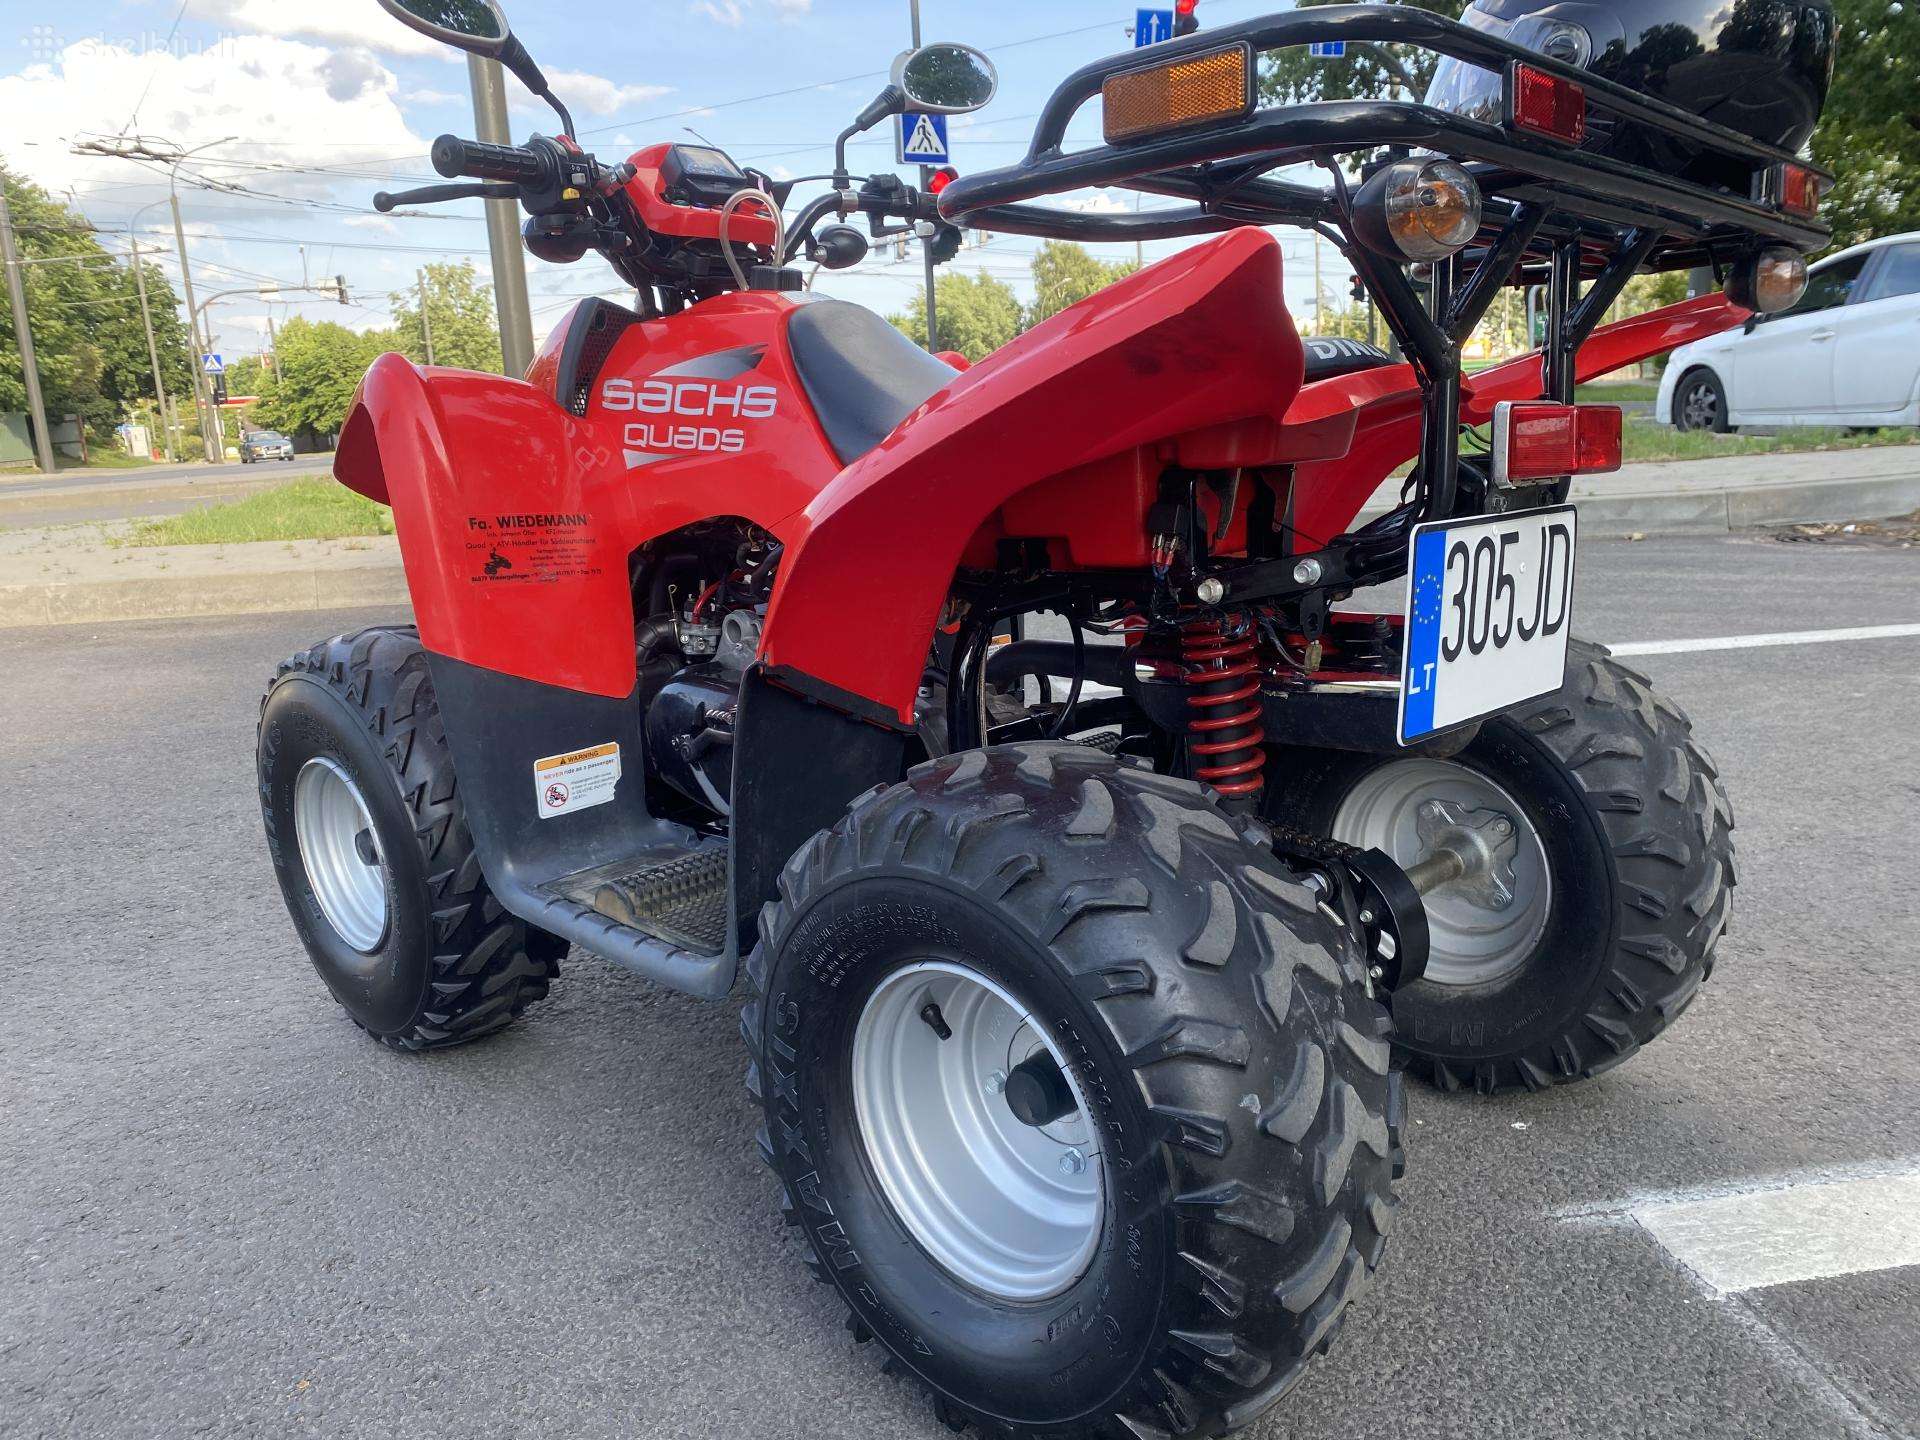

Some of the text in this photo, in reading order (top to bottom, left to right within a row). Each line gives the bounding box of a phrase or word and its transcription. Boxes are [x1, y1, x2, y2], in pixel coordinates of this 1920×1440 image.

[468, 514, 588, 530] Fa. WIEDEMANN
[1441, 523, 1570, 663] 305JD
[1408, 663, 1435, 695] LT
[567, 750, 599, 763] WARNING
[587, 758, 614, 770] passenger
[772, 992, 862, 1271] MAXXIS
